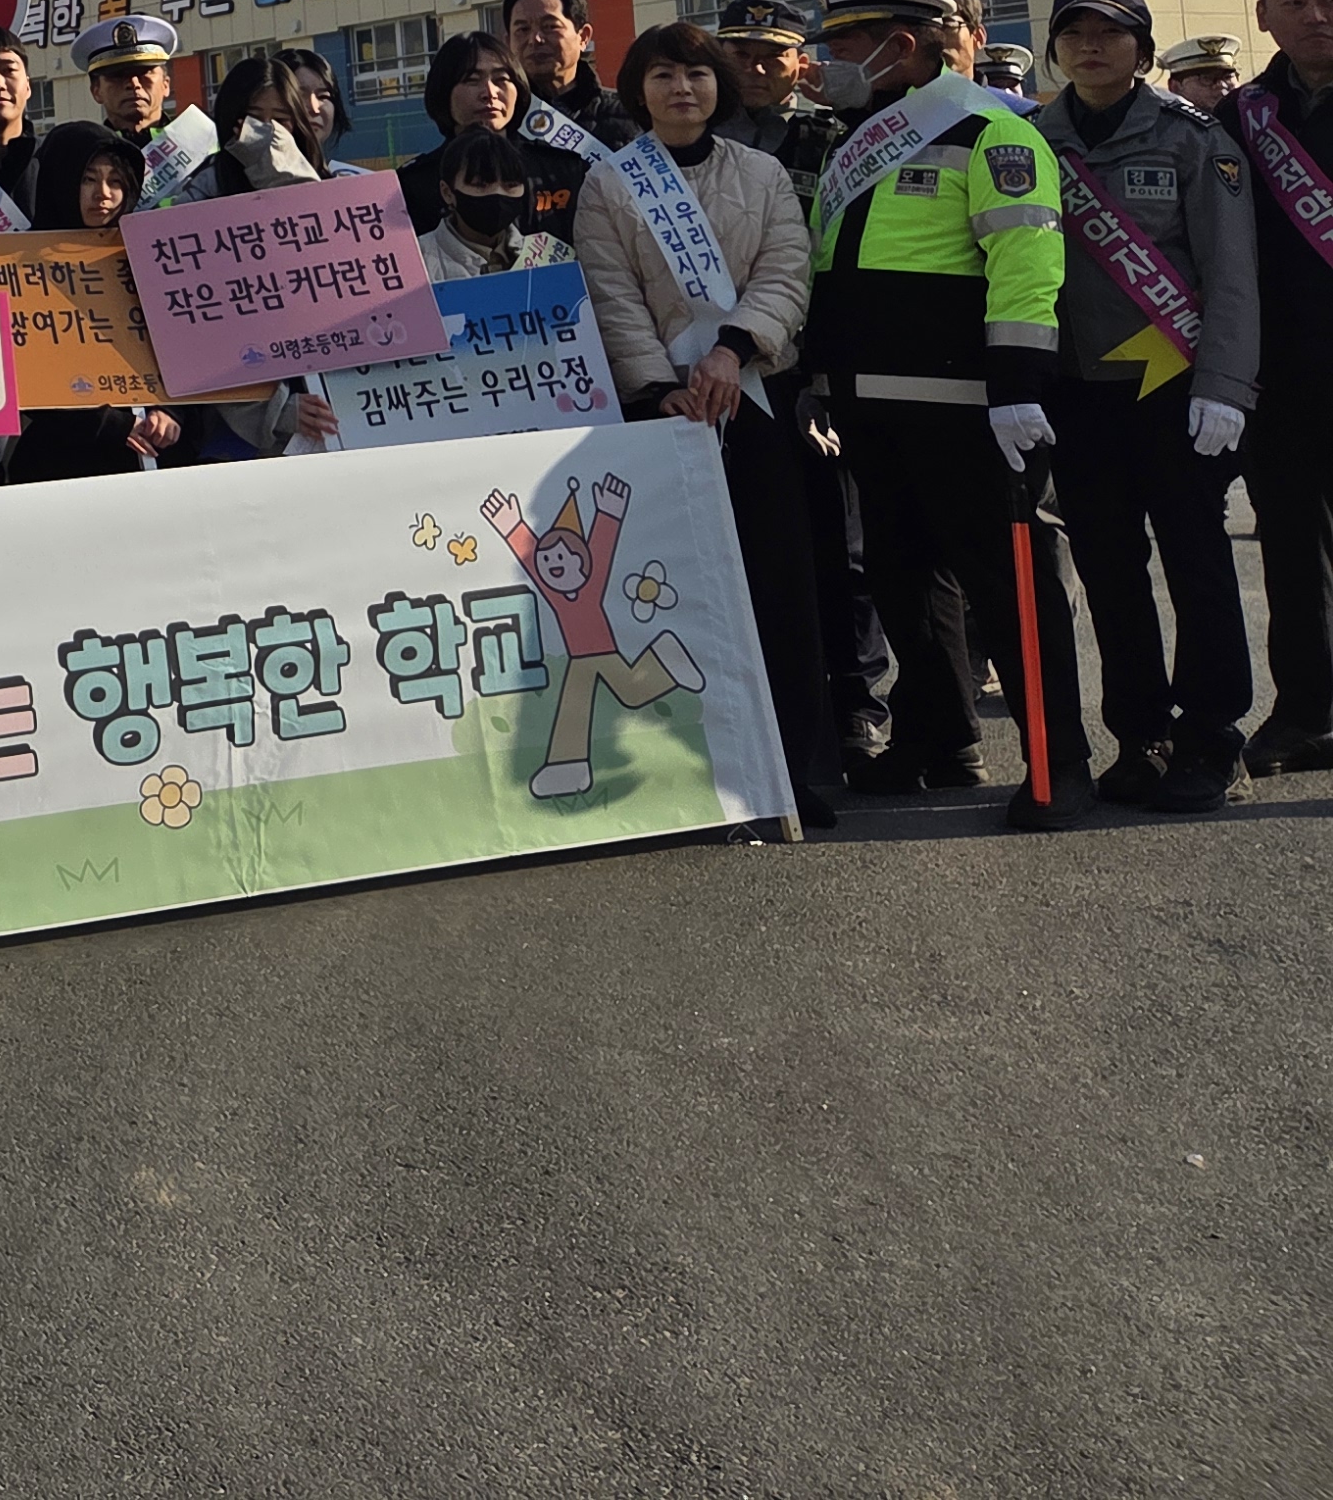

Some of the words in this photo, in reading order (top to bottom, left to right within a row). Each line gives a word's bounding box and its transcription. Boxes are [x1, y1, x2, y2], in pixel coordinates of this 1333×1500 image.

[839, 110, 909, 176] 교통신호
[846, 128, 923, 192] 무단횡단
[536, 189, 571, 212] 119
[902, 169, 937, 184] 모범
[1129, 170, 1172, 186] 경찰
[1130, 188, 1172, 197] POLICE
[152, 233, 206, 275] 친구
[215, 221, 266, 263] 사랑
[271, 213, 329, 252] 학교
[333, 203, 385, 242] 사랑
[620, 157, 659, 198] 먼저
[648, 204, 709, 302] 지킵시다
[675, 201, 721, 274] 우리가
[164, 283, 223, 324] 작은
[226, 272, 284, 315] 관심
[286, 258, 370, 303] 커다란
[372, 252, 404, 291] 힘
[269, 329, 364, 360] 의령초등학교
[465, 304, 580, 357] 친구마음
[98, 374, 161, 394] 의령초등
[357, 377, 469, 427] 감싸주는
[481, 355, 593, 407] 우리우정
[61, 603, 348, 769] 행복한
[373, 585, 546, 719] 학교
